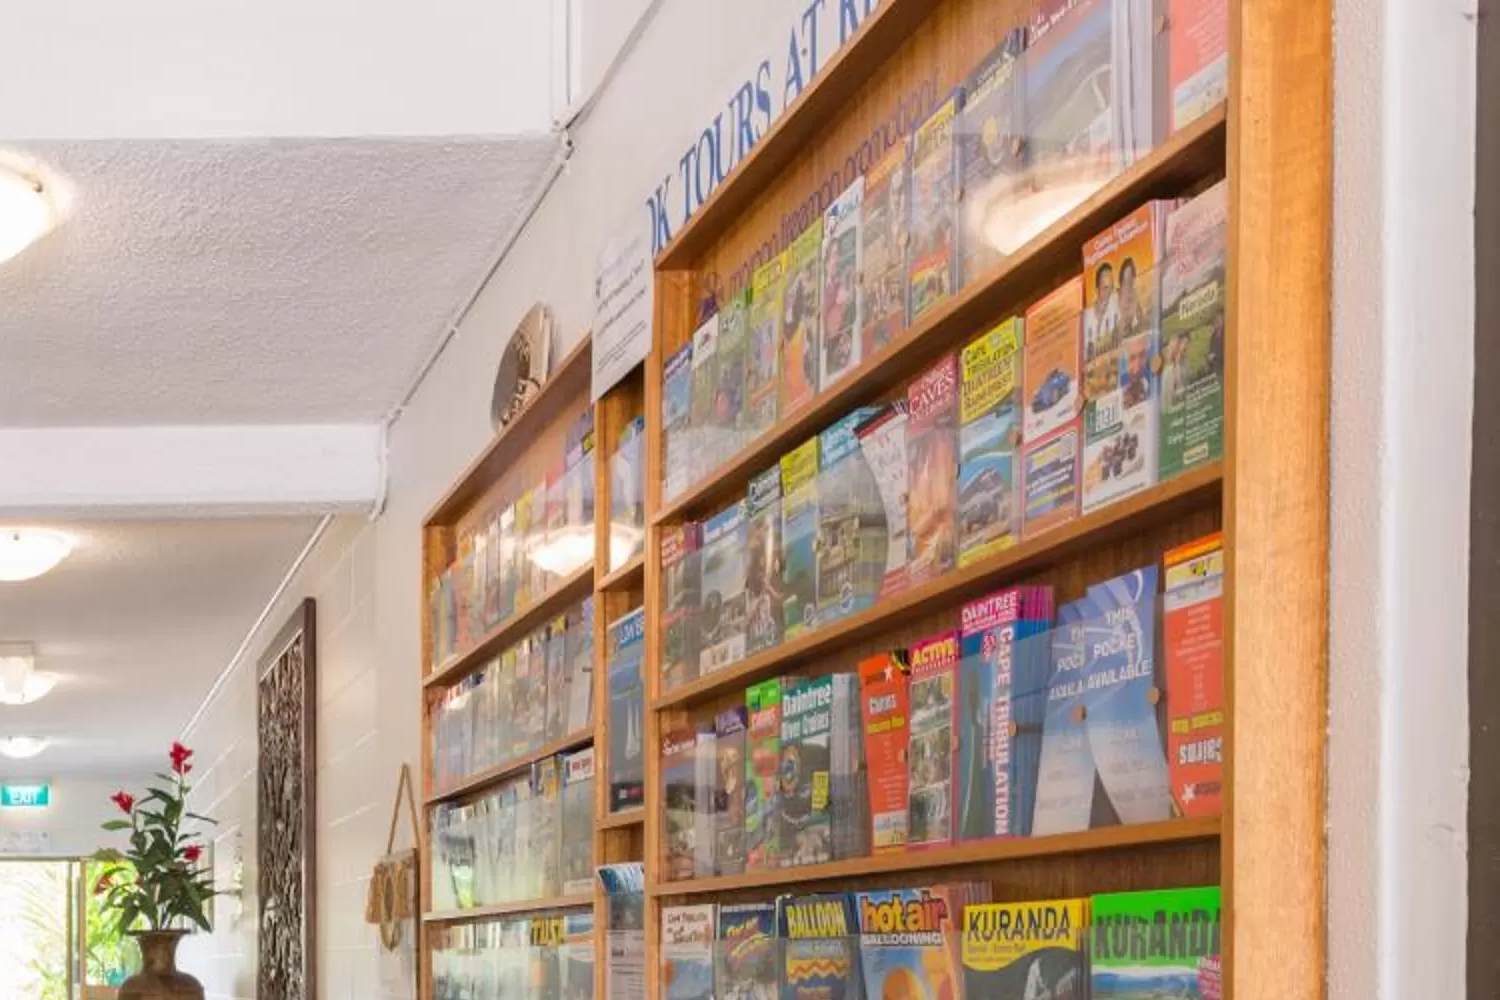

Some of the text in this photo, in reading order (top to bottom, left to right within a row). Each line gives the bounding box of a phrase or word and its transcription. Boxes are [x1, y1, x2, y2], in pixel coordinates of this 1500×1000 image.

[679, 59, 771, 226] TOURS
[784, 0, 826, 112] AT
[909, 369, 954, 415] CAVES
[961, 590, 1020, 623] DAINTREE
[1087, 658, 1153, 691] AVAILABLE
[995, 627, 1014, 836] CAPE TRIBULATION
[787, 901, 847, 939] BALLOON
[862, 890, 947, 933] hot air
[967, 906, 1071, 942] KURANDA
[861, 932, 943, 946] BALLOONING
